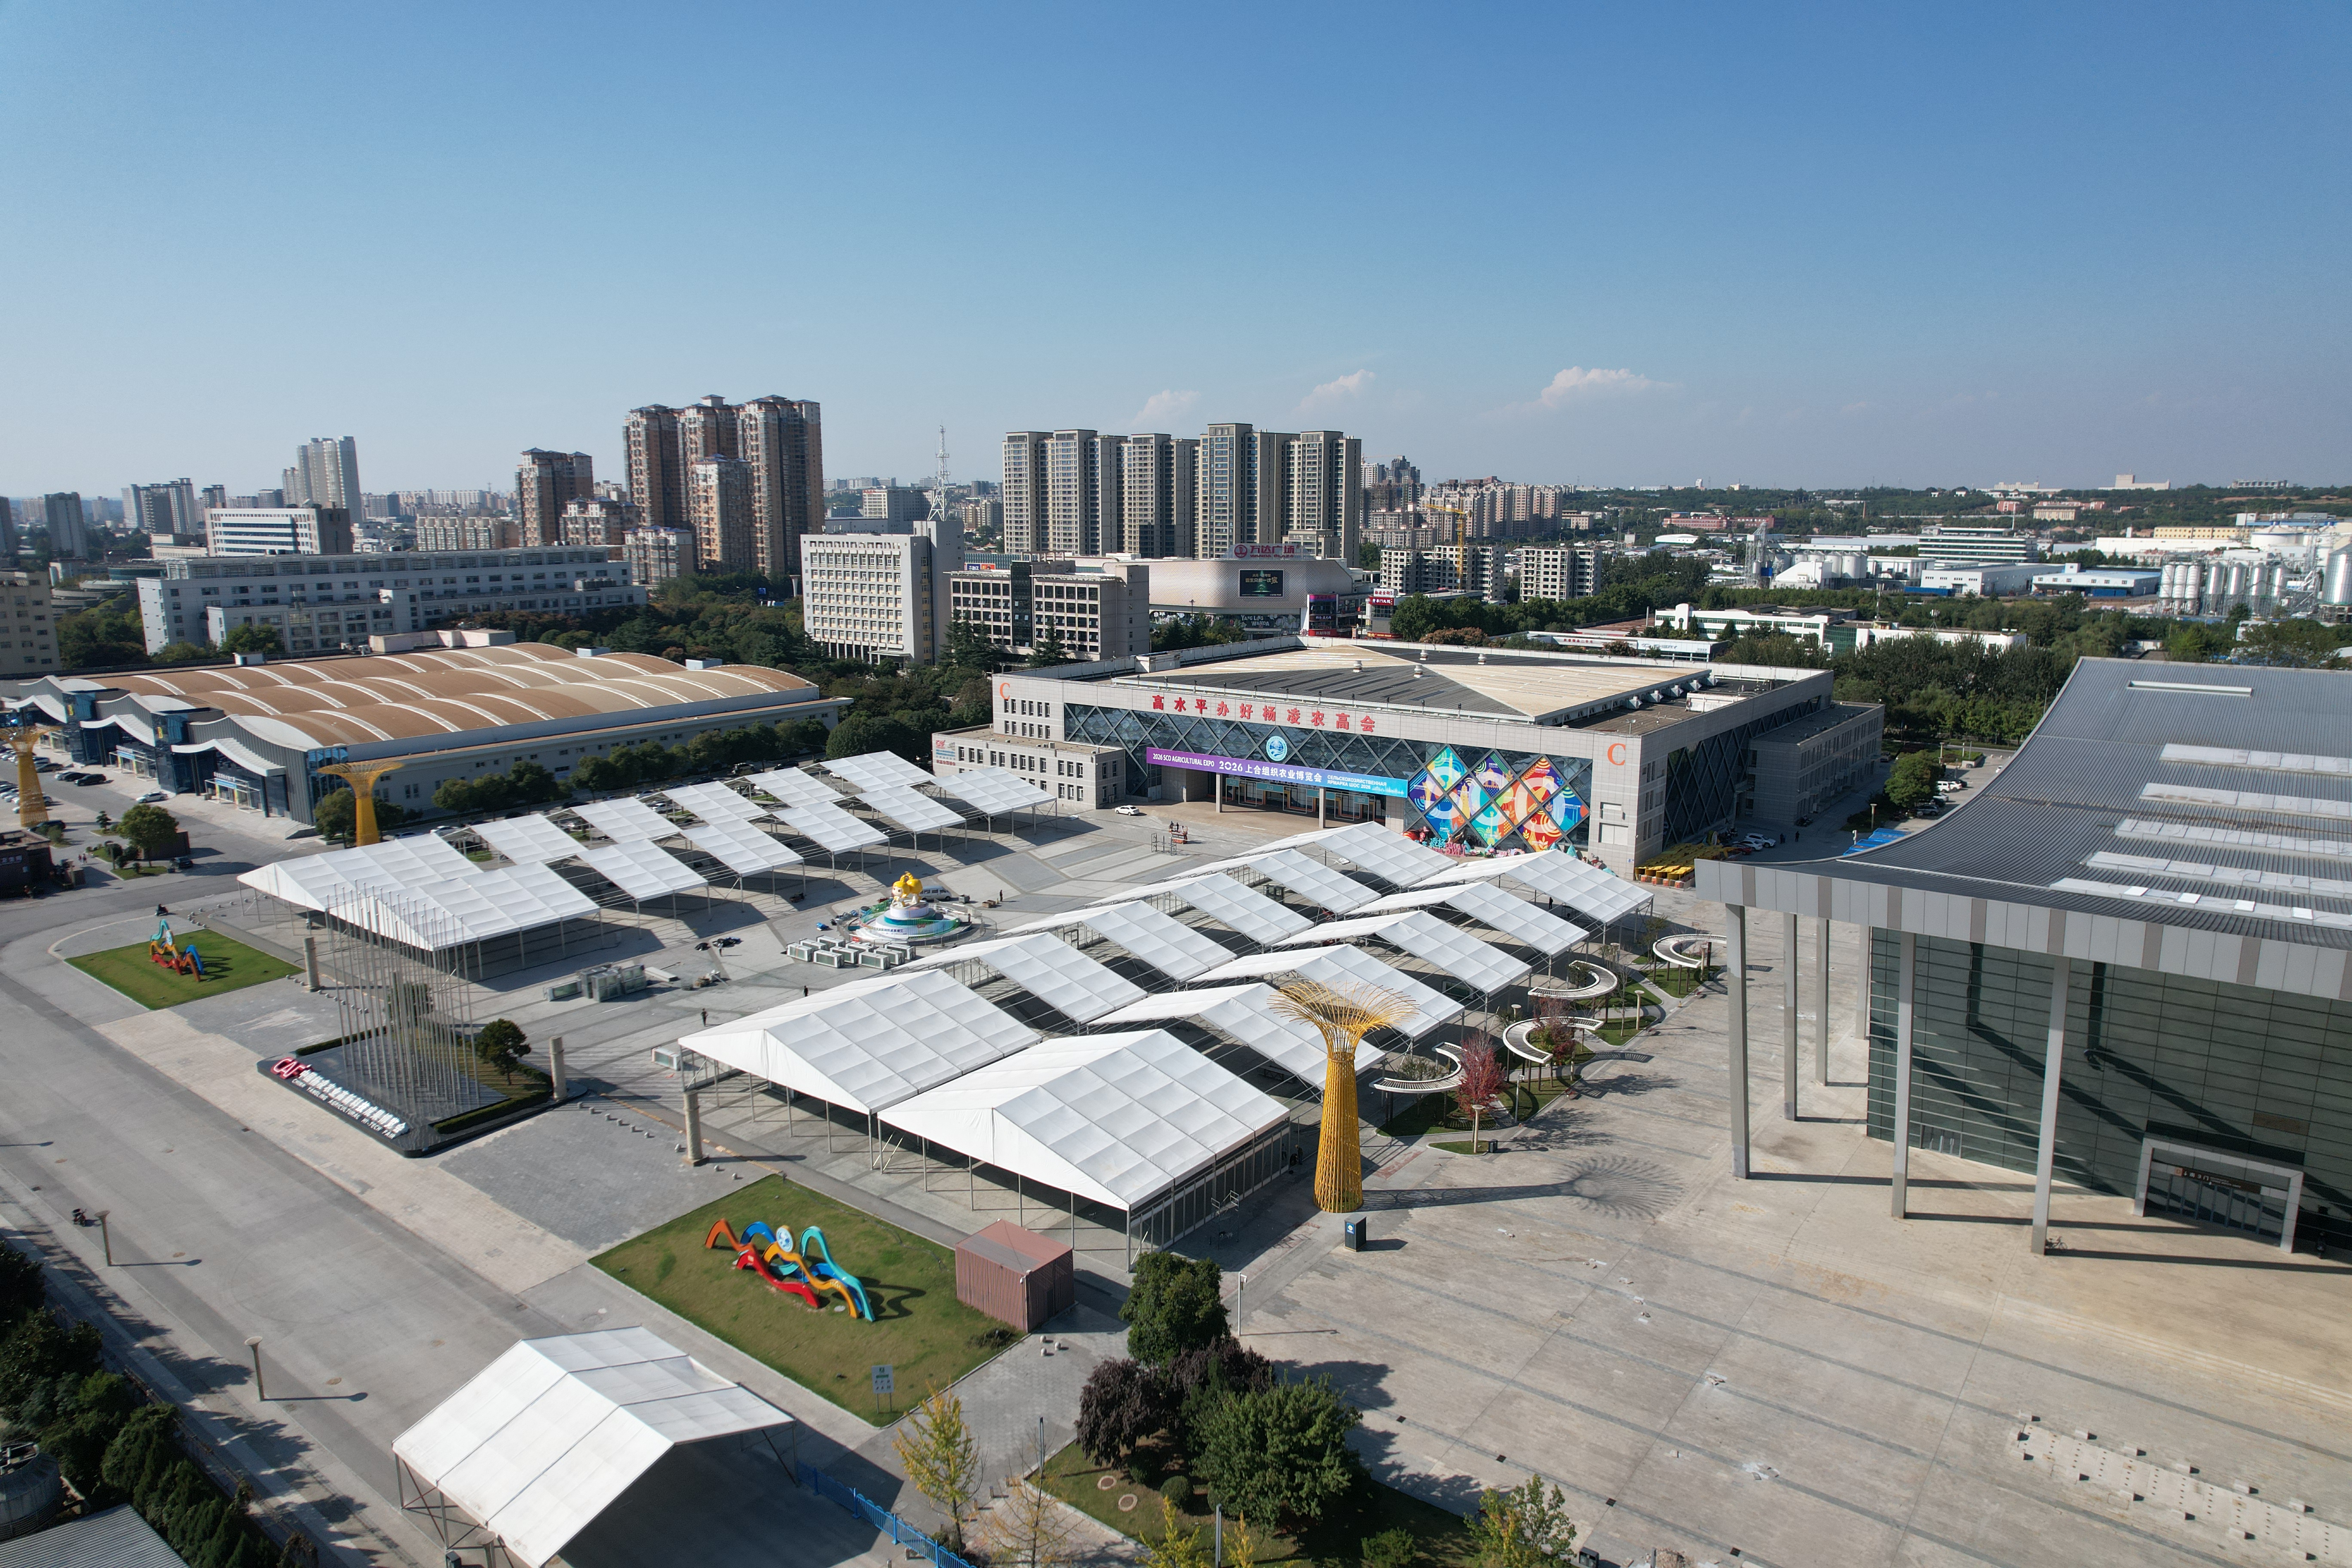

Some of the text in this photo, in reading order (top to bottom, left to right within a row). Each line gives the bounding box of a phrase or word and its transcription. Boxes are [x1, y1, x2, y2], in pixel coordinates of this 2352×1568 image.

[1250, 545, 1295, 554] 万达广场
[999, 683, 1010, 700] C
[67, 704, 74, 716] B
[1152, 695, 1375, 732] 高水平办好杨凌农高会
[157, 727, 163, 738] B
[1172, 756, 1203, 766] AGRICULTURAL
[1607, 743, 1626, 766] C
[1219, 761, 1322, 783] 2026 上合组织农业博览会
[1327, 775, 1387, 786] СЕЛЬСКОХОЗЯЙСТВЕННАЯ
[291, 1078, 307, 1088] CHINA
[306, 1086, 329, 1101] YANGLING
[328, 1099, 362, 1120] AGRICULTURAL
[382, 1130, 396, 1139] FAIR
